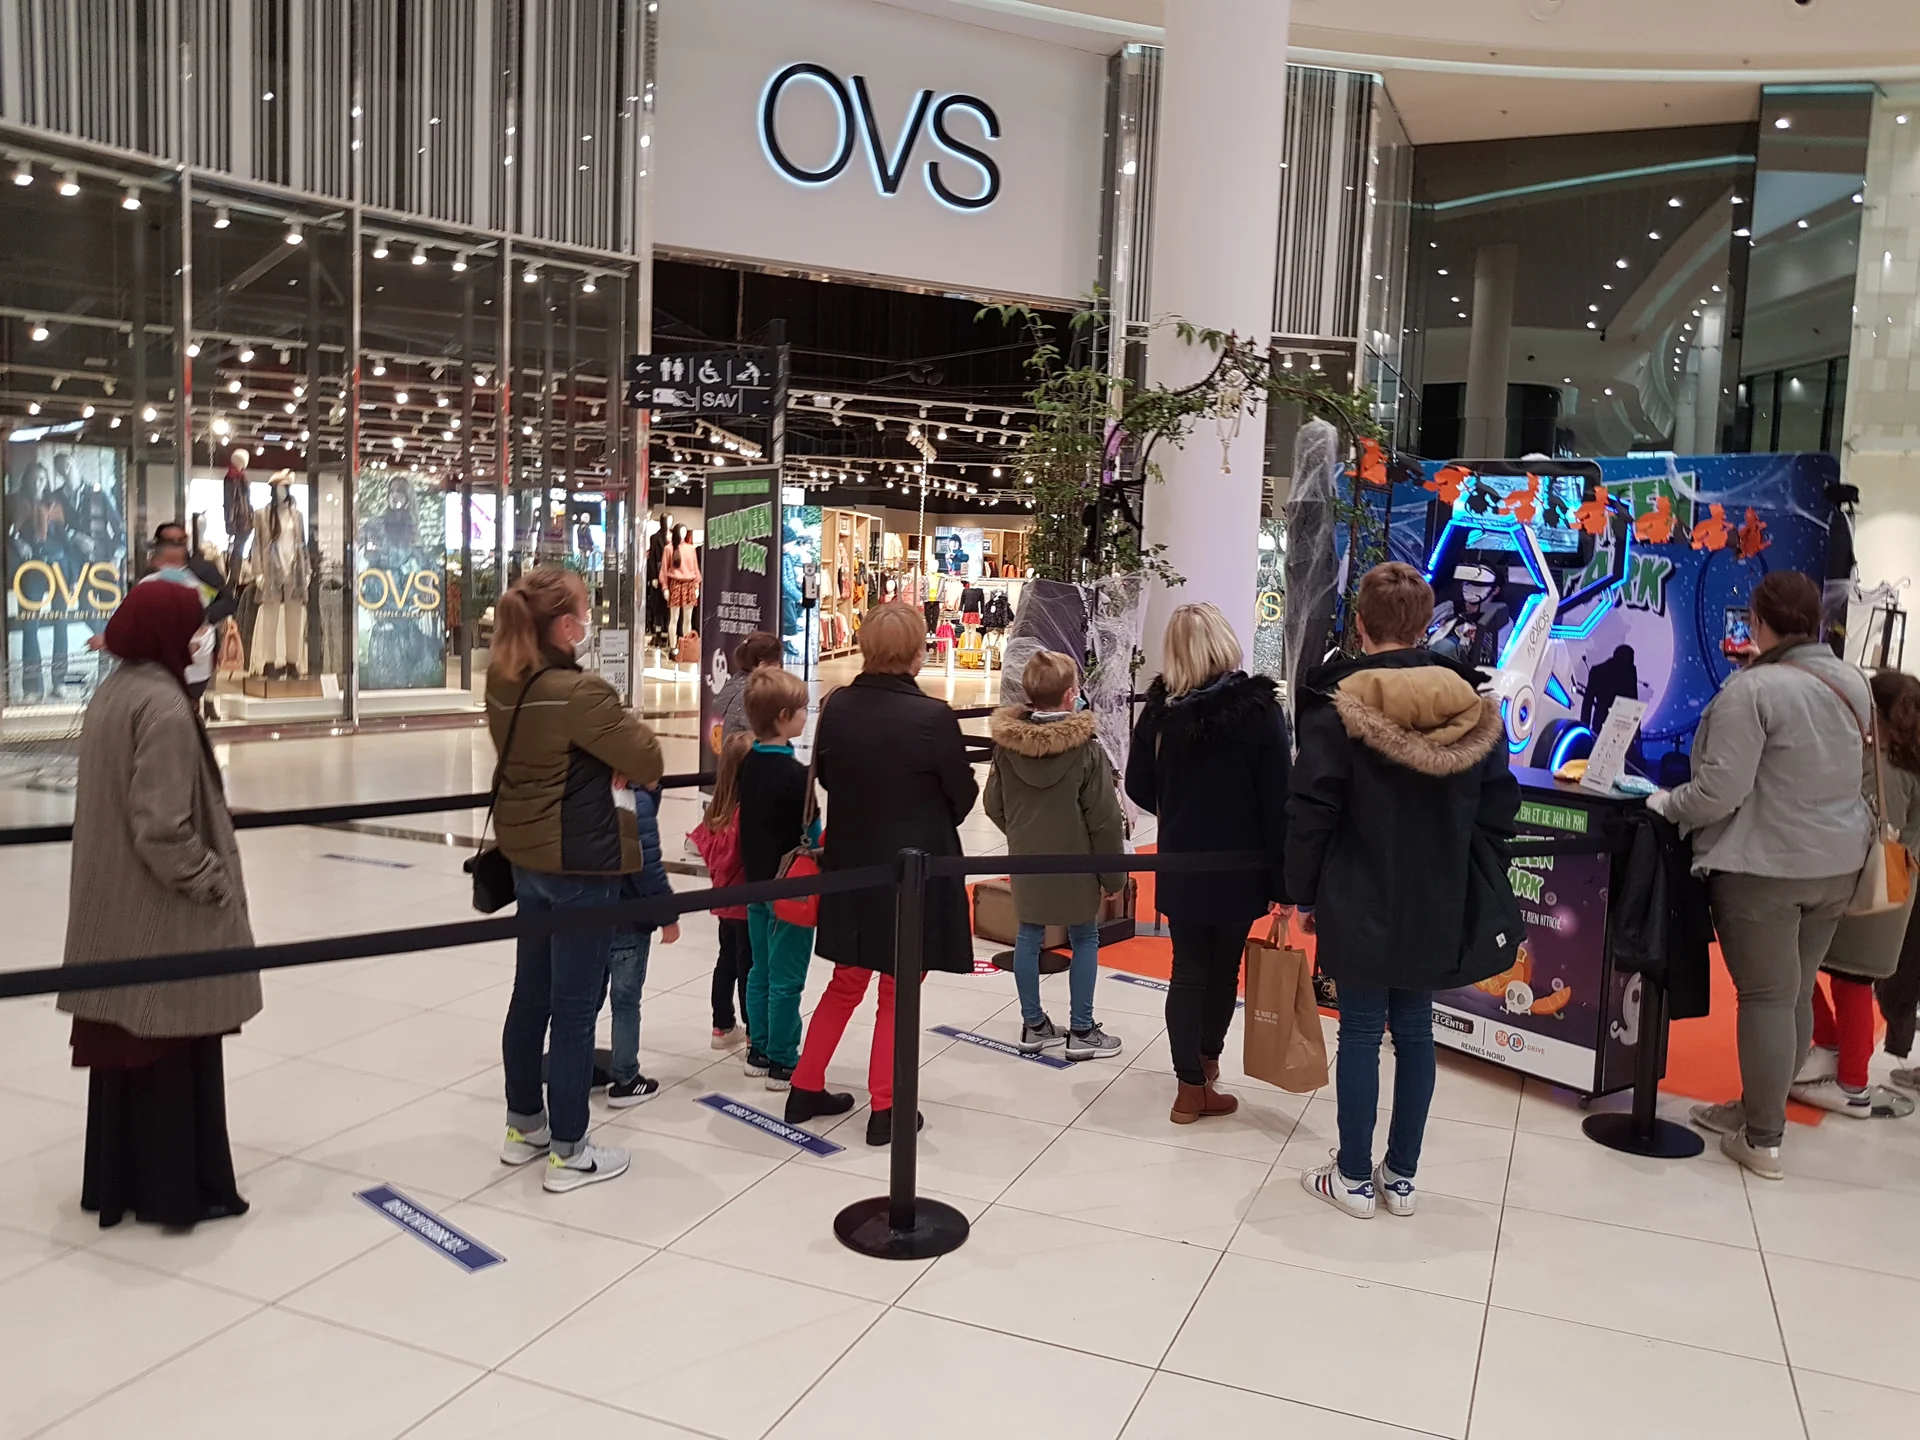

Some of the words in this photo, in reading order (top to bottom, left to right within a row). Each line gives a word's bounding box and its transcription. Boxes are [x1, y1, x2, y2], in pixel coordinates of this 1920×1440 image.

[758, 61, 1001, 211] OVS
[702, 391, 738, 408] SAV
[737, 539, 769, 577] PARK
[13, 559, 122, 611] OVS
[358, 568, 441, 611] OVS
[1532, 807, 1541, 823] ET
[1542, 809, 1551, 825] DE
[1565, 809, 1571, 829] À
[1508, 866, 1545, 904] ARK
[1526, 910, 1540, 925] BIEN
[1460, 1041, 1486, 1056] RENNES
[1486, 1051, 1506, 1062] NORD
[1496, 1032, 1508, 1042] 50
[1526, 1045, 1545, 1055] DRIVE
